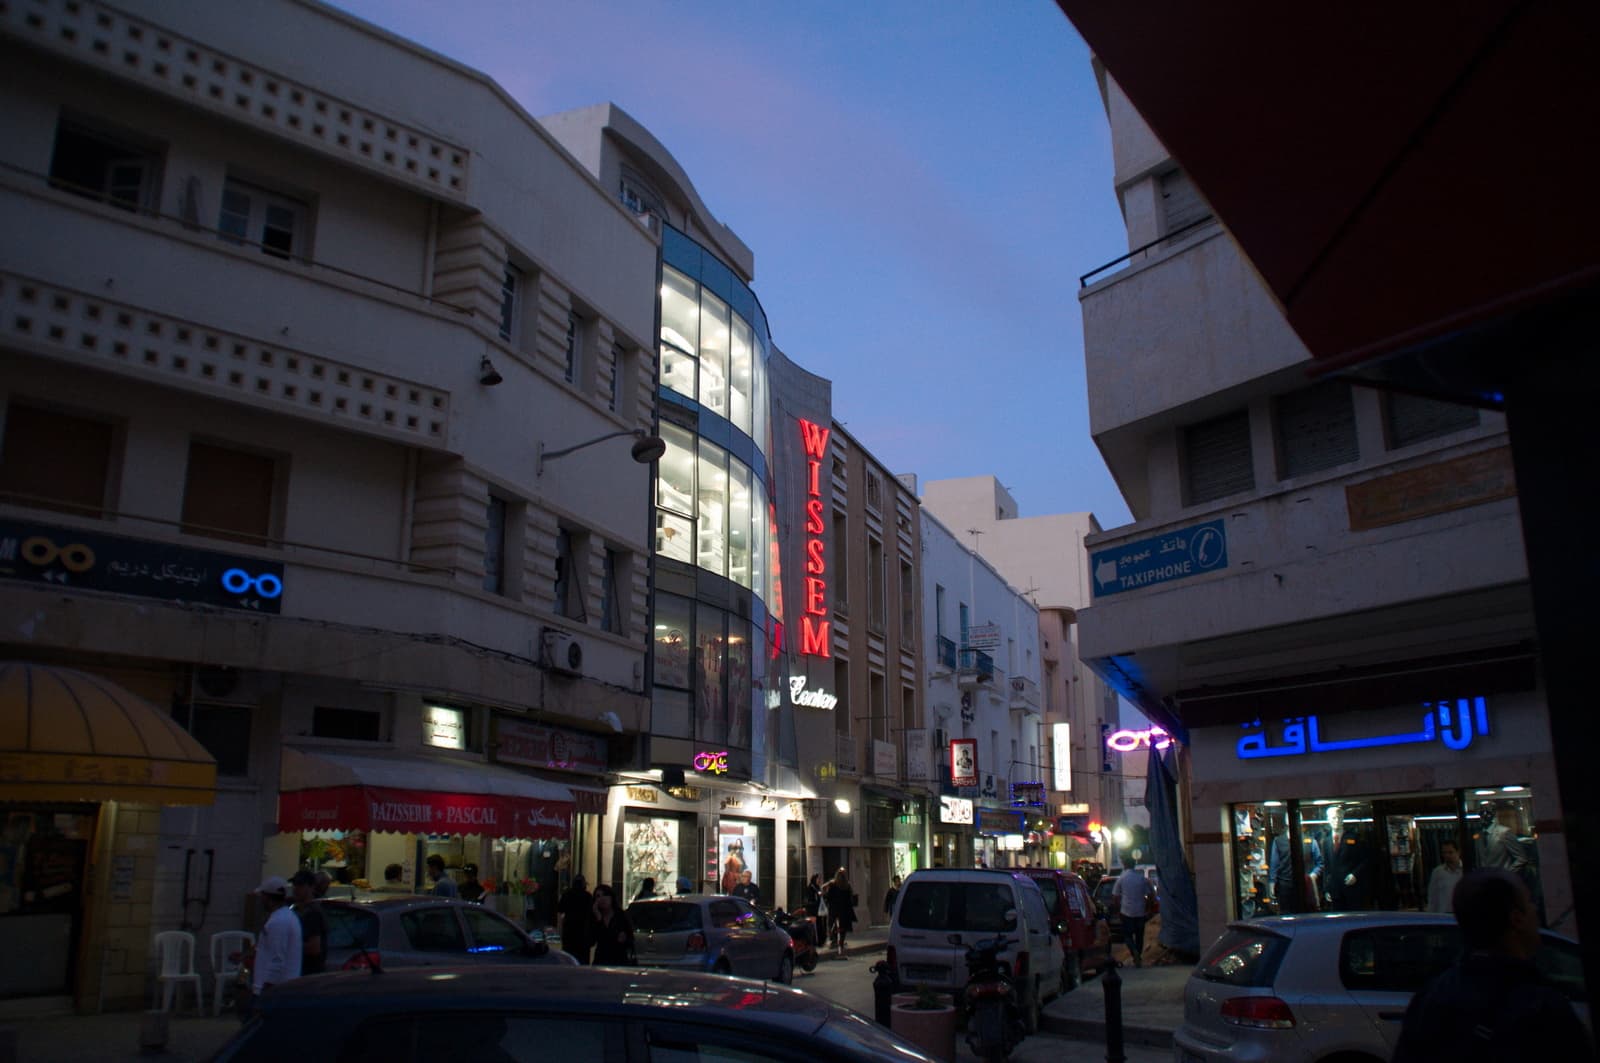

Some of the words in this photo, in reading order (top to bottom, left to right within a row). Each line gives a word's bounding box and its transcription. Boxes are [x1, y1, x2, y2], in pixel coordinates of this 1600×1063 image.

[798, 417, 833, 659] WISSEM
[1160, 537, 1188, 554] هاتف
[1119, 549, 1152, 568] عمومي
[1120, 560, 1192, 588] TAXIPHONE
[446, 806, 497, 824] PASCAL
